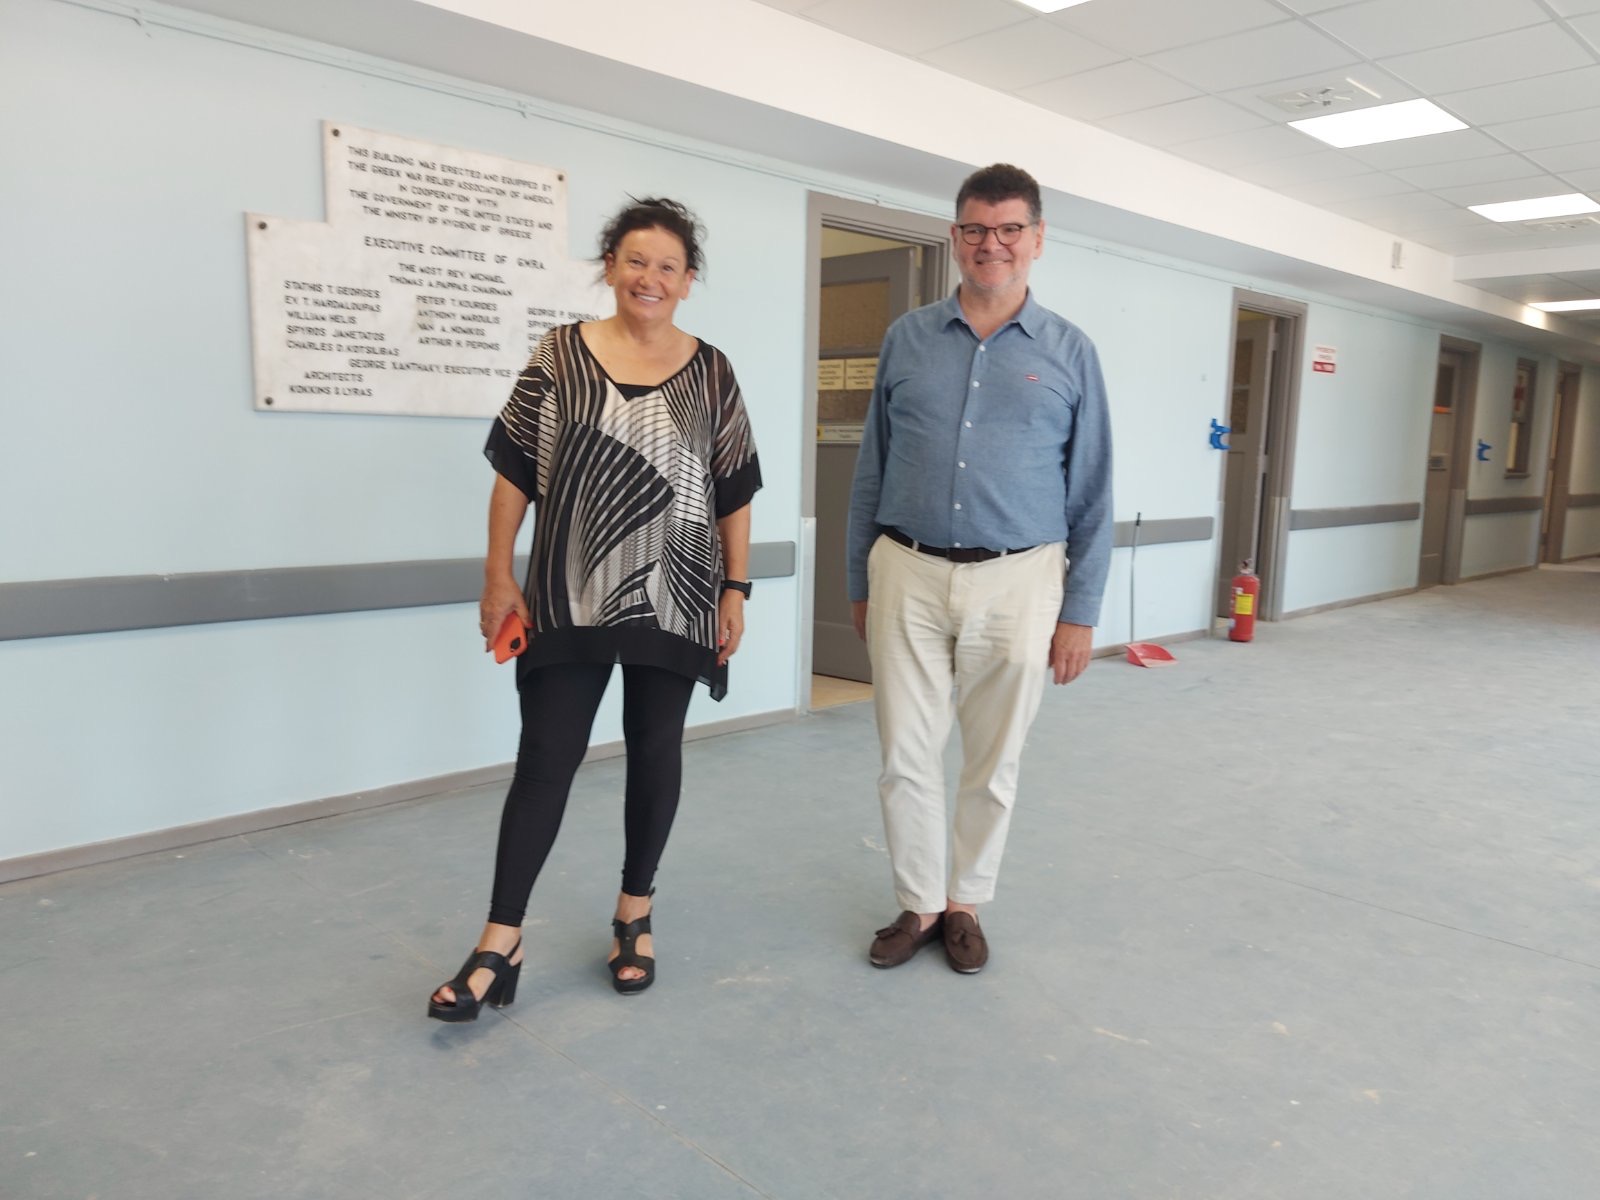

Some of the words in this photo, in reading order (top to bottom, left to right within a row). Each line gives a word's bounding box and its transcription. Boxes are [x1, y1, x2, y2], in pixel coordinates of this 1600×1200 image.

[347, 146, 369, 158] THIS
[372, 151, 414, 166] BUILDING
[418, 160, 437, 171] WAS
[440, 164, 481, 179] ERECTED
[483, 174, 499, 182] AND
[501, 176, 538, 190] EQUIPPED
[542, 184, 552, 192] BY
[347, 161, 367, 172] THE
[371, 165, 401, 177] GREEK
[405, 172, 422, 181] WAR
[425, 175, 455, 187] RELIEF
[457, 182, 506, 196] ASSOCIATION
[509, 191, 521, 199] OF
[523, 195, 553, 205] AMERICA
[398, 184, 408, 192] IN
[411, 186, 470, 202] COOPERATION
[476, 198, 498, 207] WITH
[349, 189, 369, 200] THE
[373, 193, 432, 209] GOVERNMENT
[438, 204, 450, 212] OF
[453, 207, 470, 217] THE
[473, 211, 501, 222] UNITED
[505, 215, 534, 227] STATES
[538, 222, 552, 230] AND
[362, 205, 381, 216] THE
[385, 210, 422, 222] MINISTRY
[427, 216, 438, 224] OF
[441, 219, 477, 231] HYGIENE
[480, 224, 491, 232] OF
[498, 227, 532, 239] GREECE
[364, 236, 425, 254] EXECUTIVE
[430, 245, 486, 262] COMMITTEE
[494, 254, 507, 264] OF
[399, 262, 417, 273] THE
[419, 266, 442, 276] MOST
[388, 275, 423, 287] THOMAS
[471, 285, 513, 297] CHAIRMAN
[416, 295, 447, 305] PETER
[286, 311, 327, 322] WILLIAM
[418, 310, 456, 320] ANTHONY
[286, 325, 327, 337] SPYROS
[286, 340, 334, 352] CHARLES
[418, 337, 453, 347] ARTHUR
[348, 358, 388, 370] GEORGE
[444, 365, 491, 377] EXECUTIVE
[304, 371, 363, 383] ARCHITECTS
